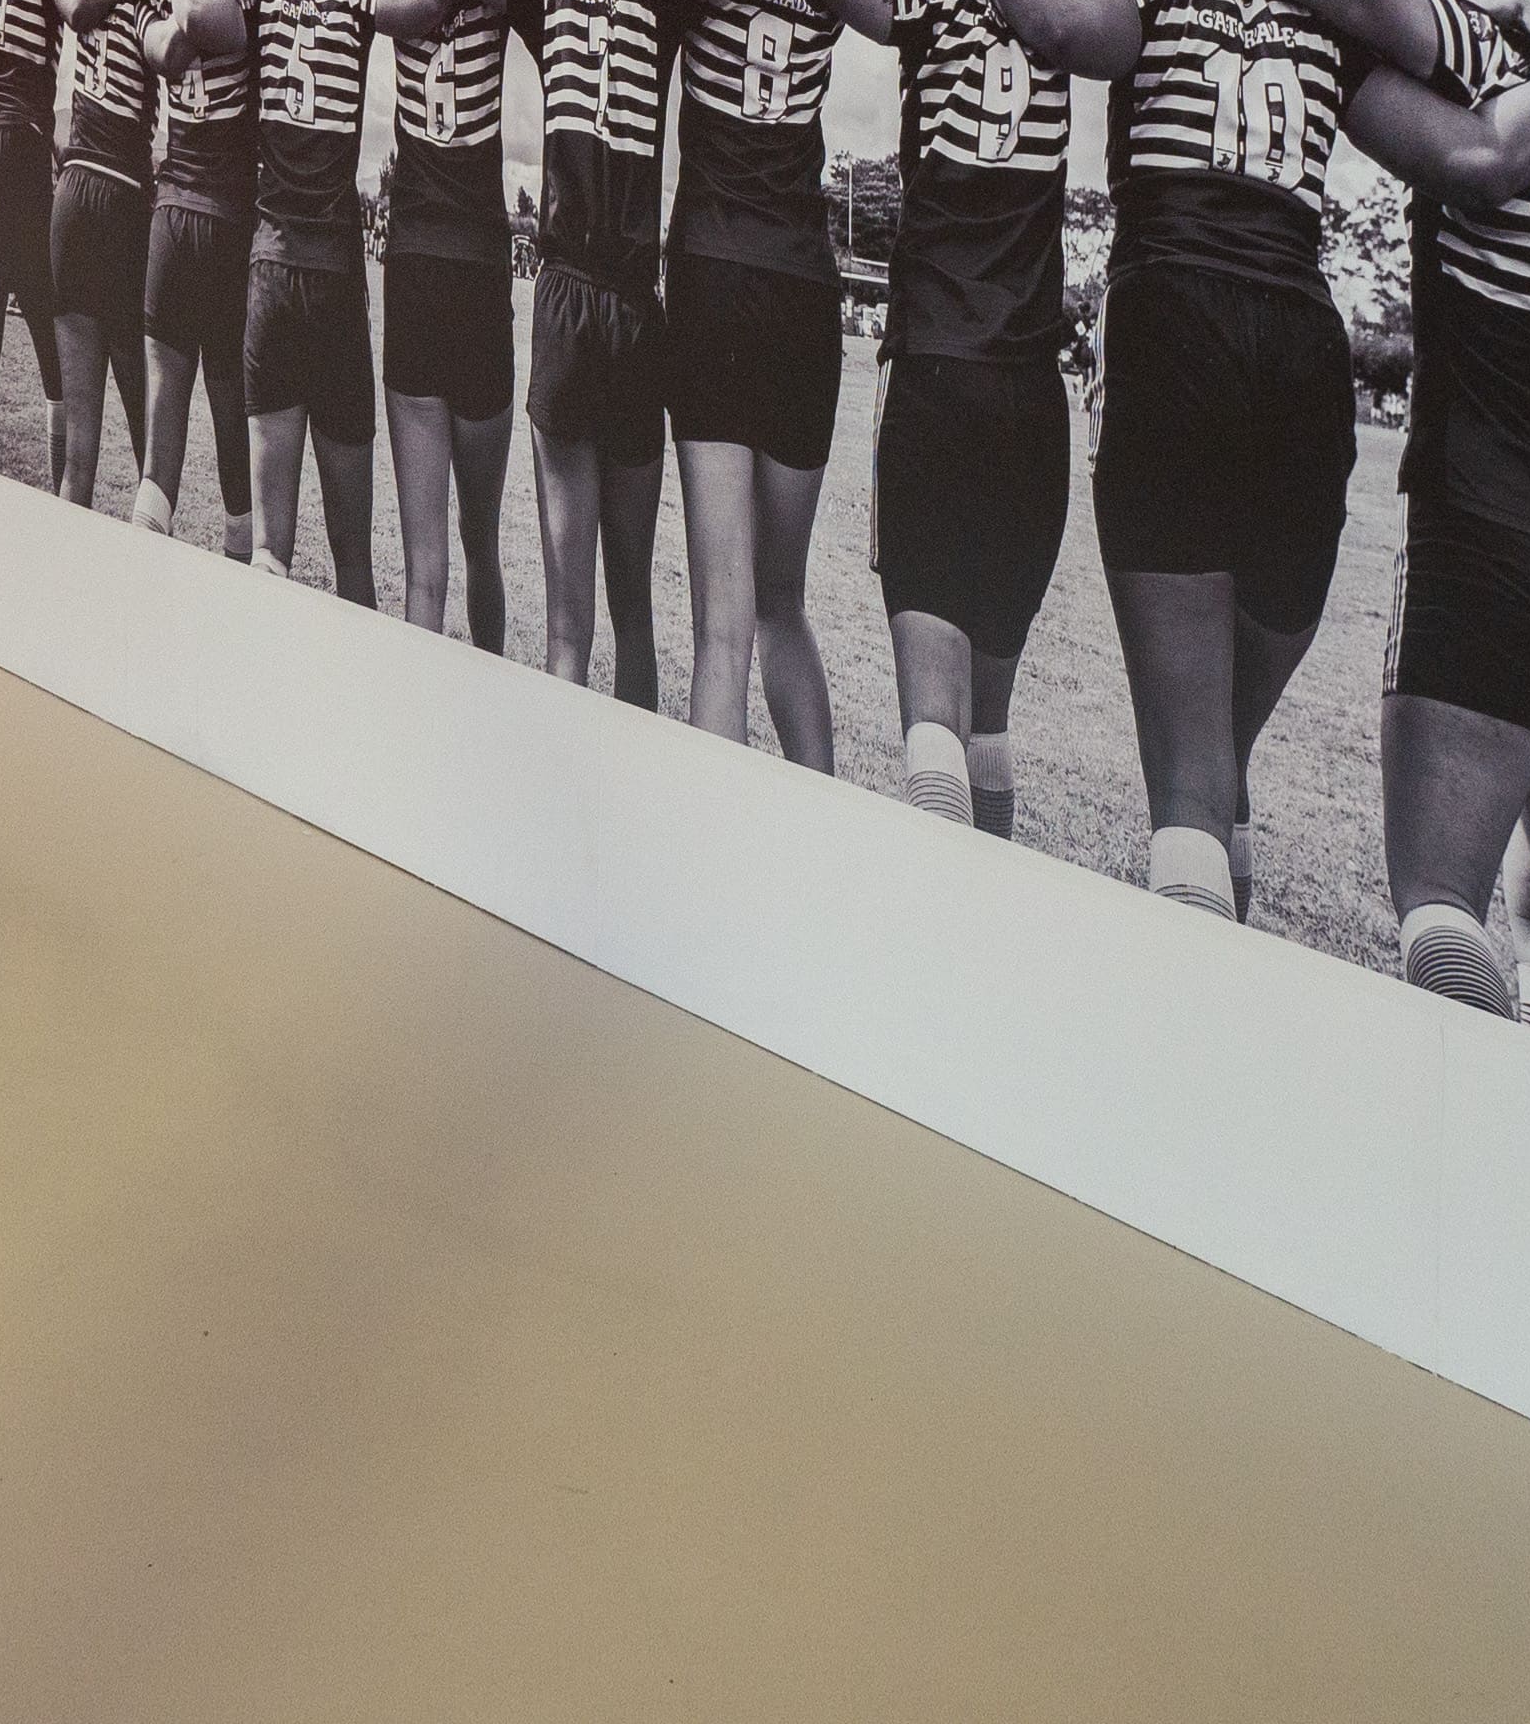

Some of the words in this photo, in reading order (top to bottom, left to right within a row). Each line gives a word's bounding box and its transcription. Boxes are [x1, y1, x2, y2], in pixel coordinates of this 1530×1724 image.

[284, 24, 316, 125] 5
[425, 40, 457, 144] 6
[741, 11, 795, 121] 8
[975, 38, 1031, 163] 9
[1202, 48, 1306, 190] 10
